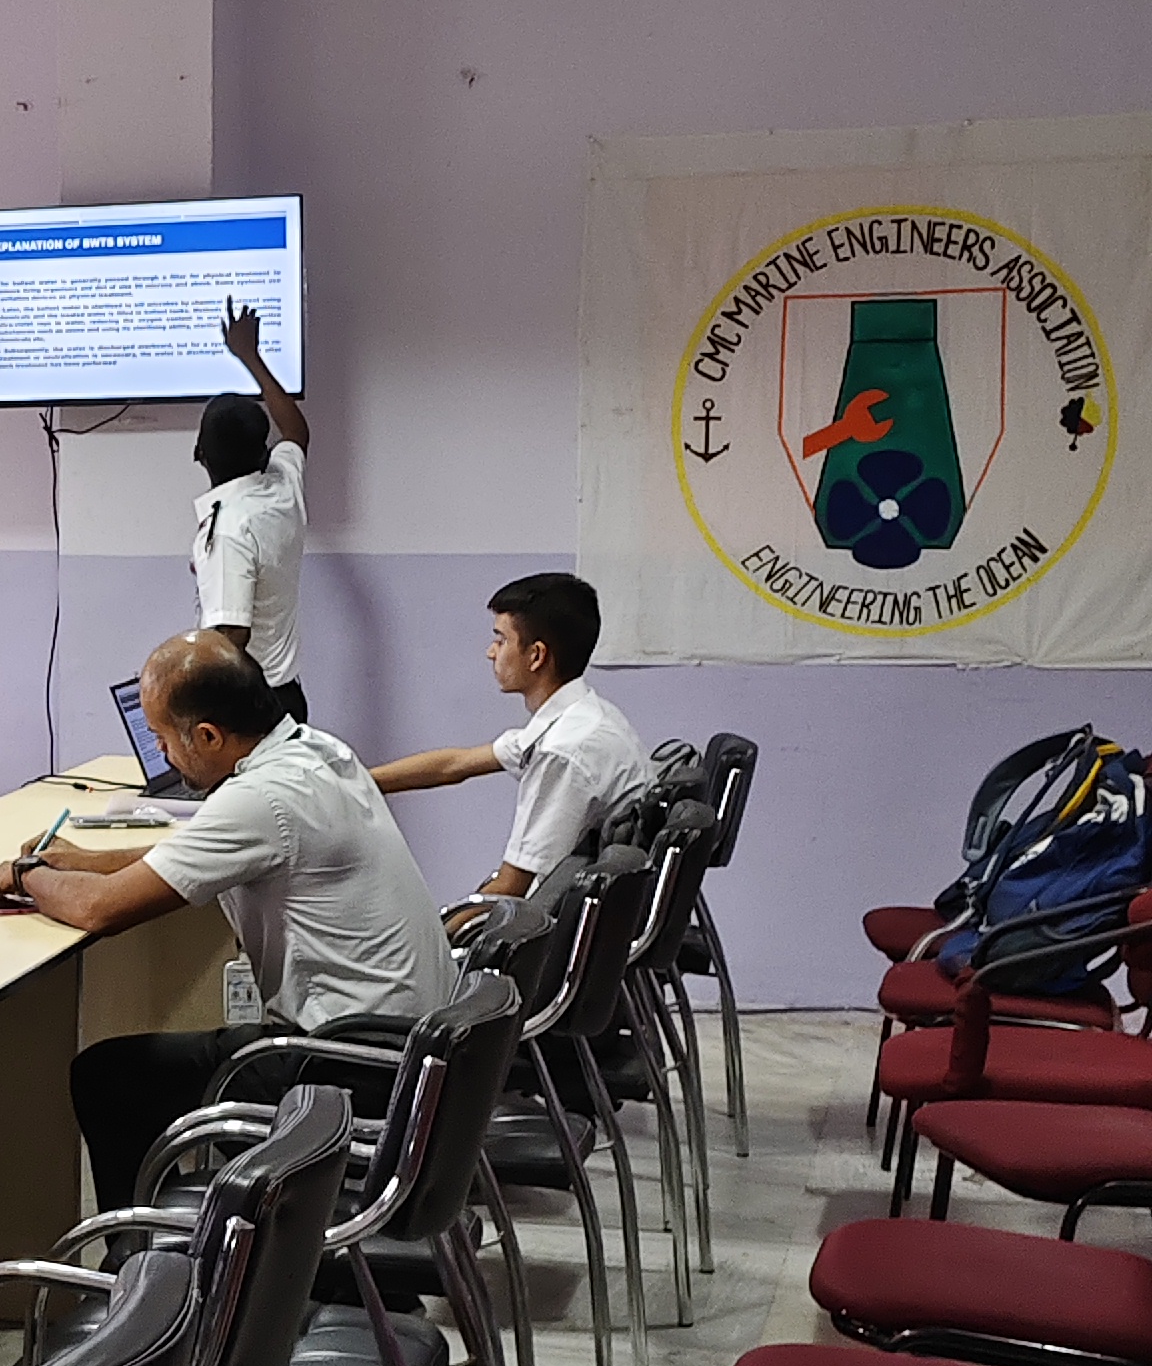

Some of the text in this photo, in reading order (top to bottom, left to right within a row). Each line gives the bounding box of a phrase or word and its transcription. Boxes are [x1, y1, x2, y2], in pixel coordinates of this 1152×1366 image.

[65, 237, 81, 250] OF
[116, 235, 163, 247] SYSTEM
[694, 218, 1100, 393] CMC MARINE ENGINEERS ASSOCIATION
[741, 527, 1049, 626] ENGINEERING THE OCEAN
